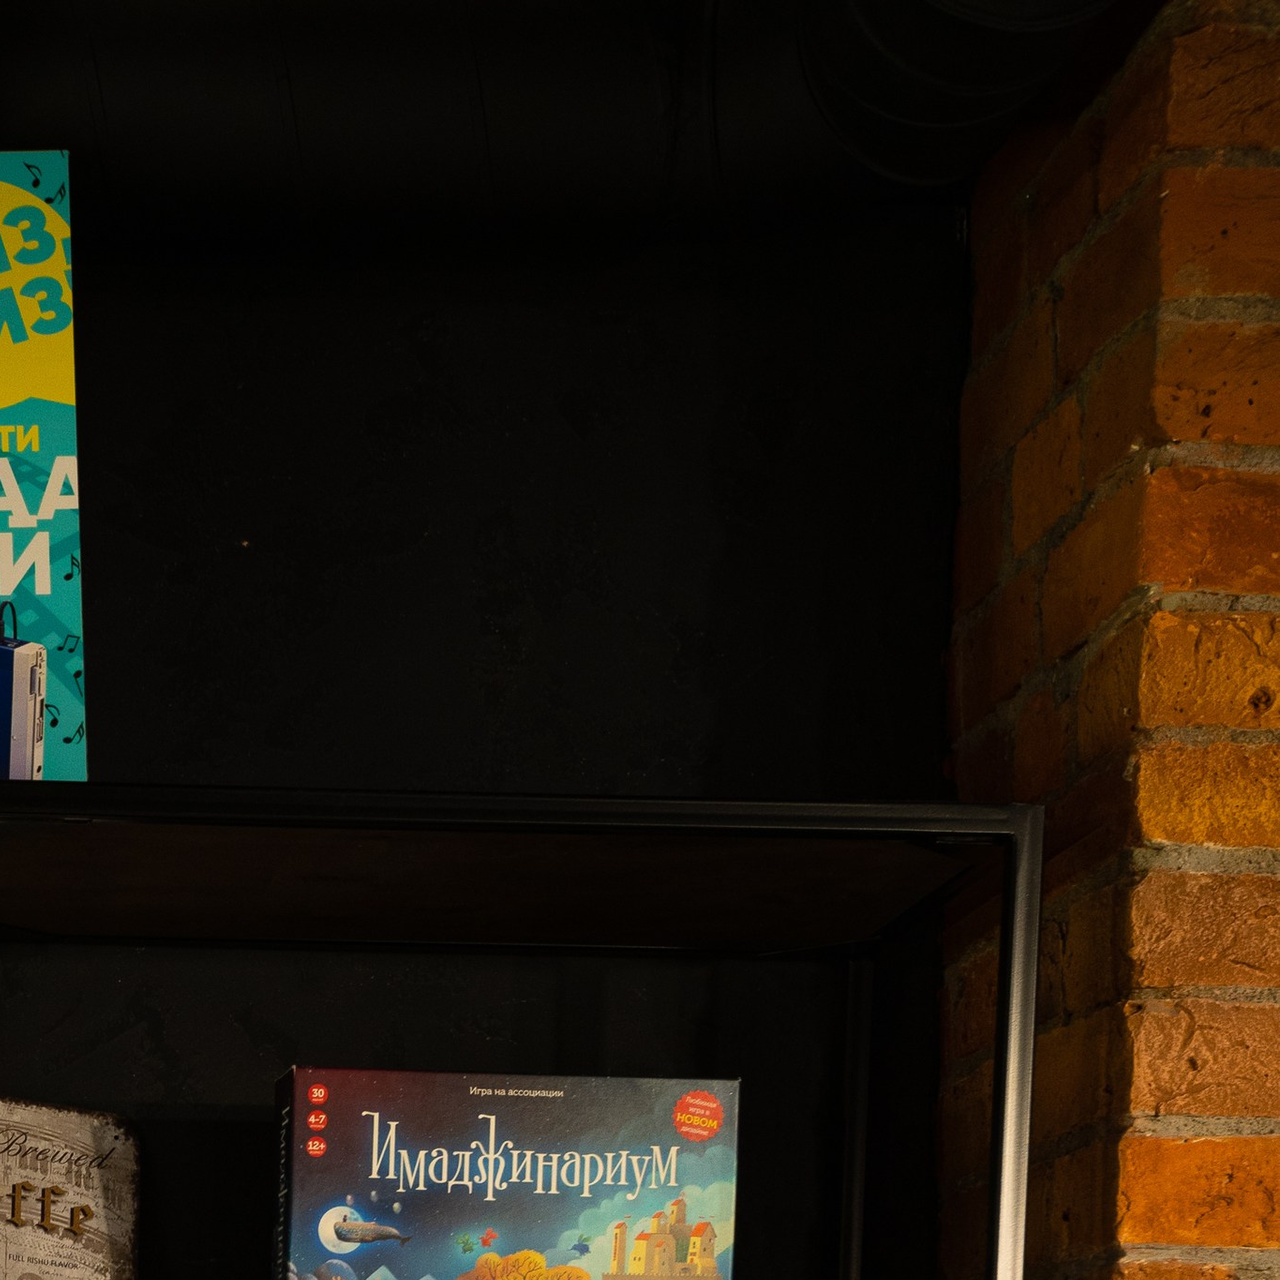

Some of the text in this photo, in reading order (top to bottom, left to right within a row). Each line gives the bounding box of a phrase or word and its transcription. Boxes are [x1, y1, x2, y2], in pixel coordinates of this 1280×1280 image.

[311, 1088, 325, 1098] 30
[469, 1086, 564, 1098] Игра на ассоциации
[676, 1112, 718, 1129] НОВОМ
[308, 1140, 326, 1151] 12+
[361, 1110, 681, 1201] Имаджинариум
[8, 1253, 24, 1263] FULL
